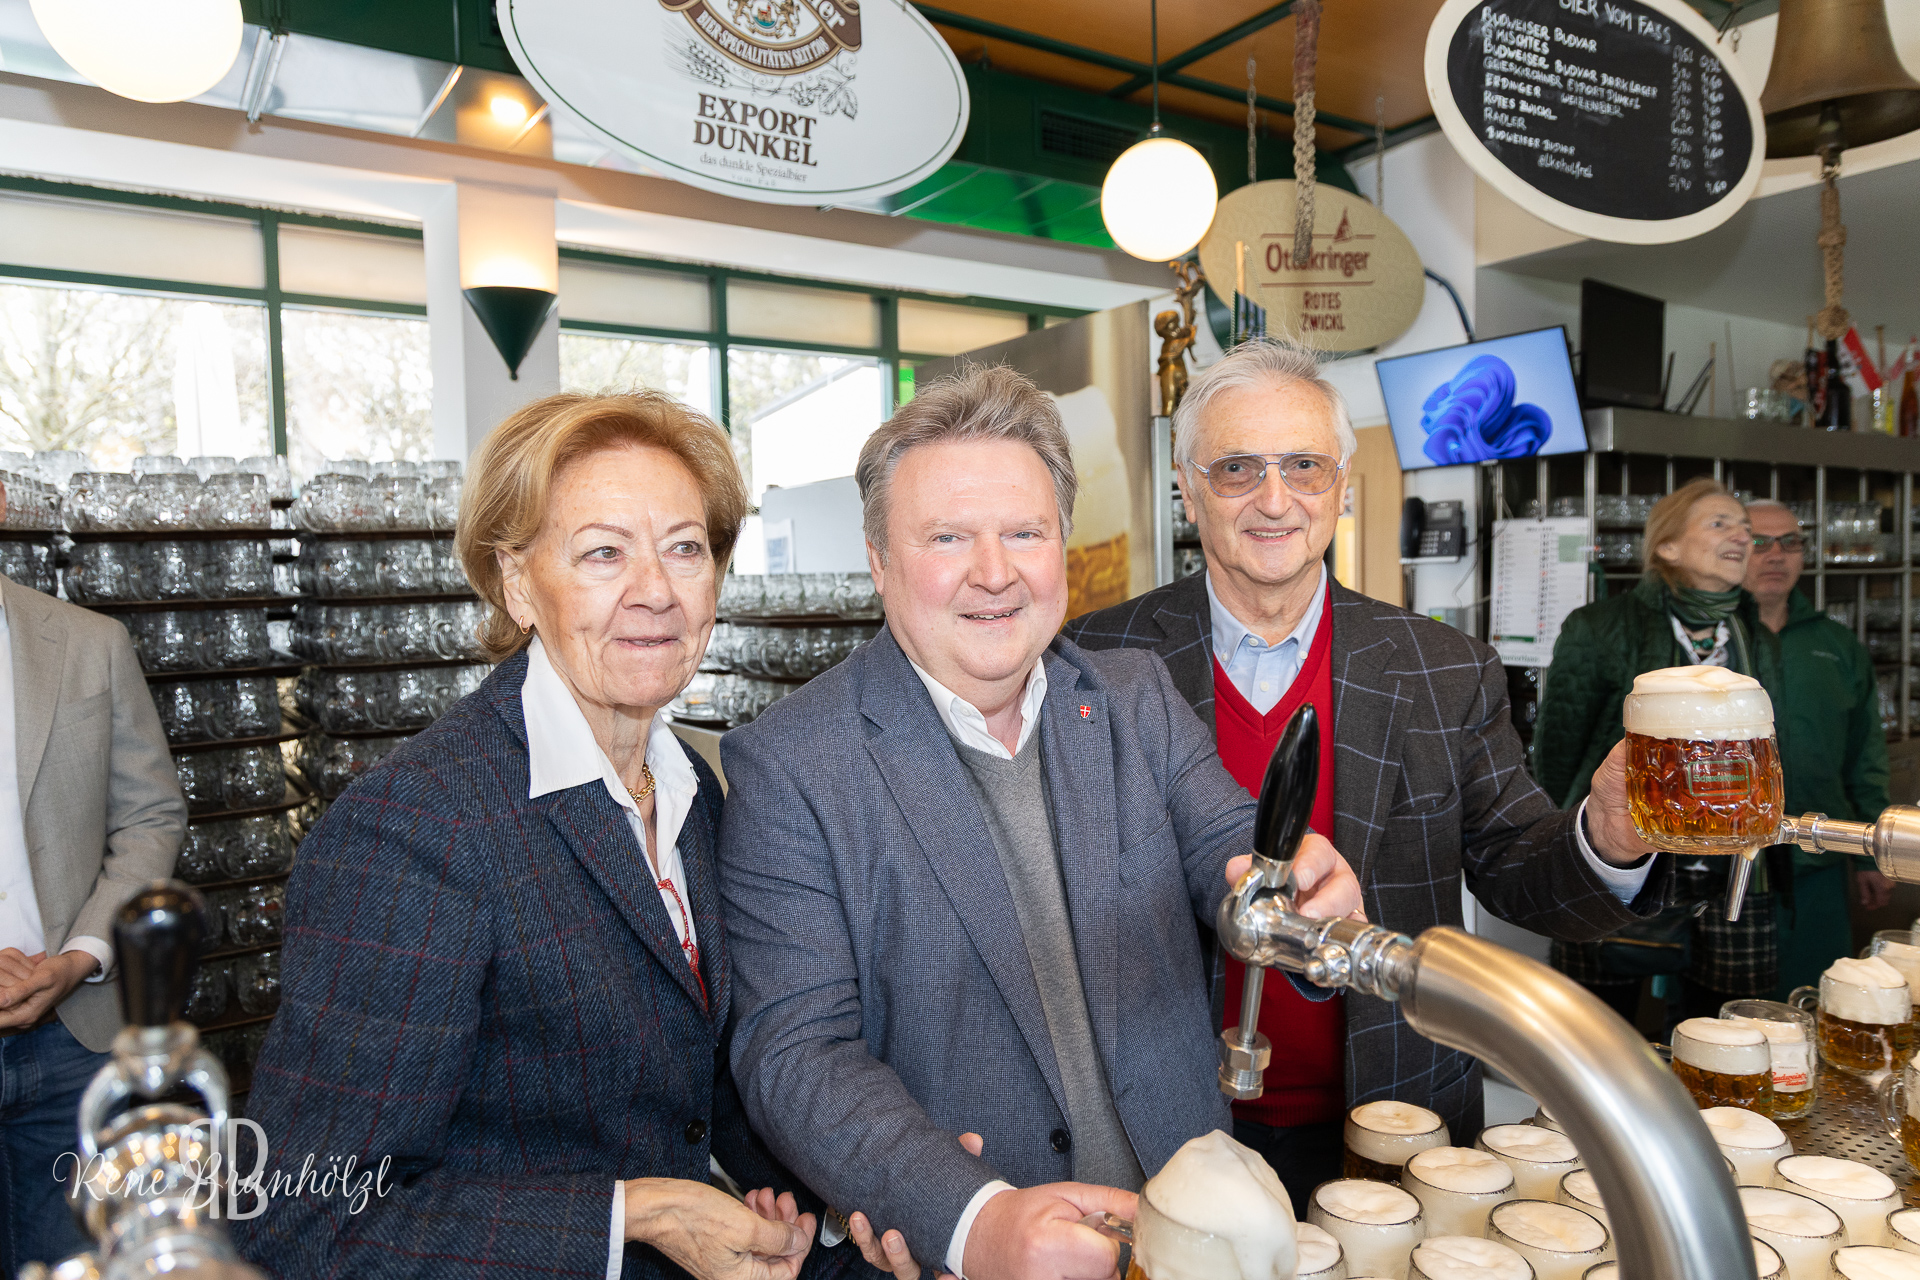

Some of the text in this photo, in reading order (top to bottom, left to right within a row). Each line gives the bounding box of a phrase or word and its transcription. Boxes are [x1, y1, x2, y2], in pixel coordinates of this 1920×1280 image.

[1481, 6, 1597, 53] BUDWEISER BUDVAR
[1604, 2, 1632, 32] VOM
[1638, 15, 1671, 45] FASS
[696, 10, 793, 68] BIER-SPECIALITÄTEN
[791, 44, 815, 67] SEIT
[1483, 37, 1549, 70] BUDWEISER
[1555, 59, 1598, 83] BUDVAR
[1600, 73, 1628, 93] DARK
[1483, 90, 1516, 110] ROTES
[1485, 72, 1541, 99] ERDINGER
[1567, 78, 1605, 99] EXPORT
[698, 92, 817, 139] EXPORT
[1483, 107, 1527, 131] RADLER
[693, 120, 818, 167] DUNKEL
[700, 152, 808, 182] das dunkle Spezialbier
[1303, 291, 1341, 310] ROTES
[1301, 313, 1345, 331] ZWICKL
